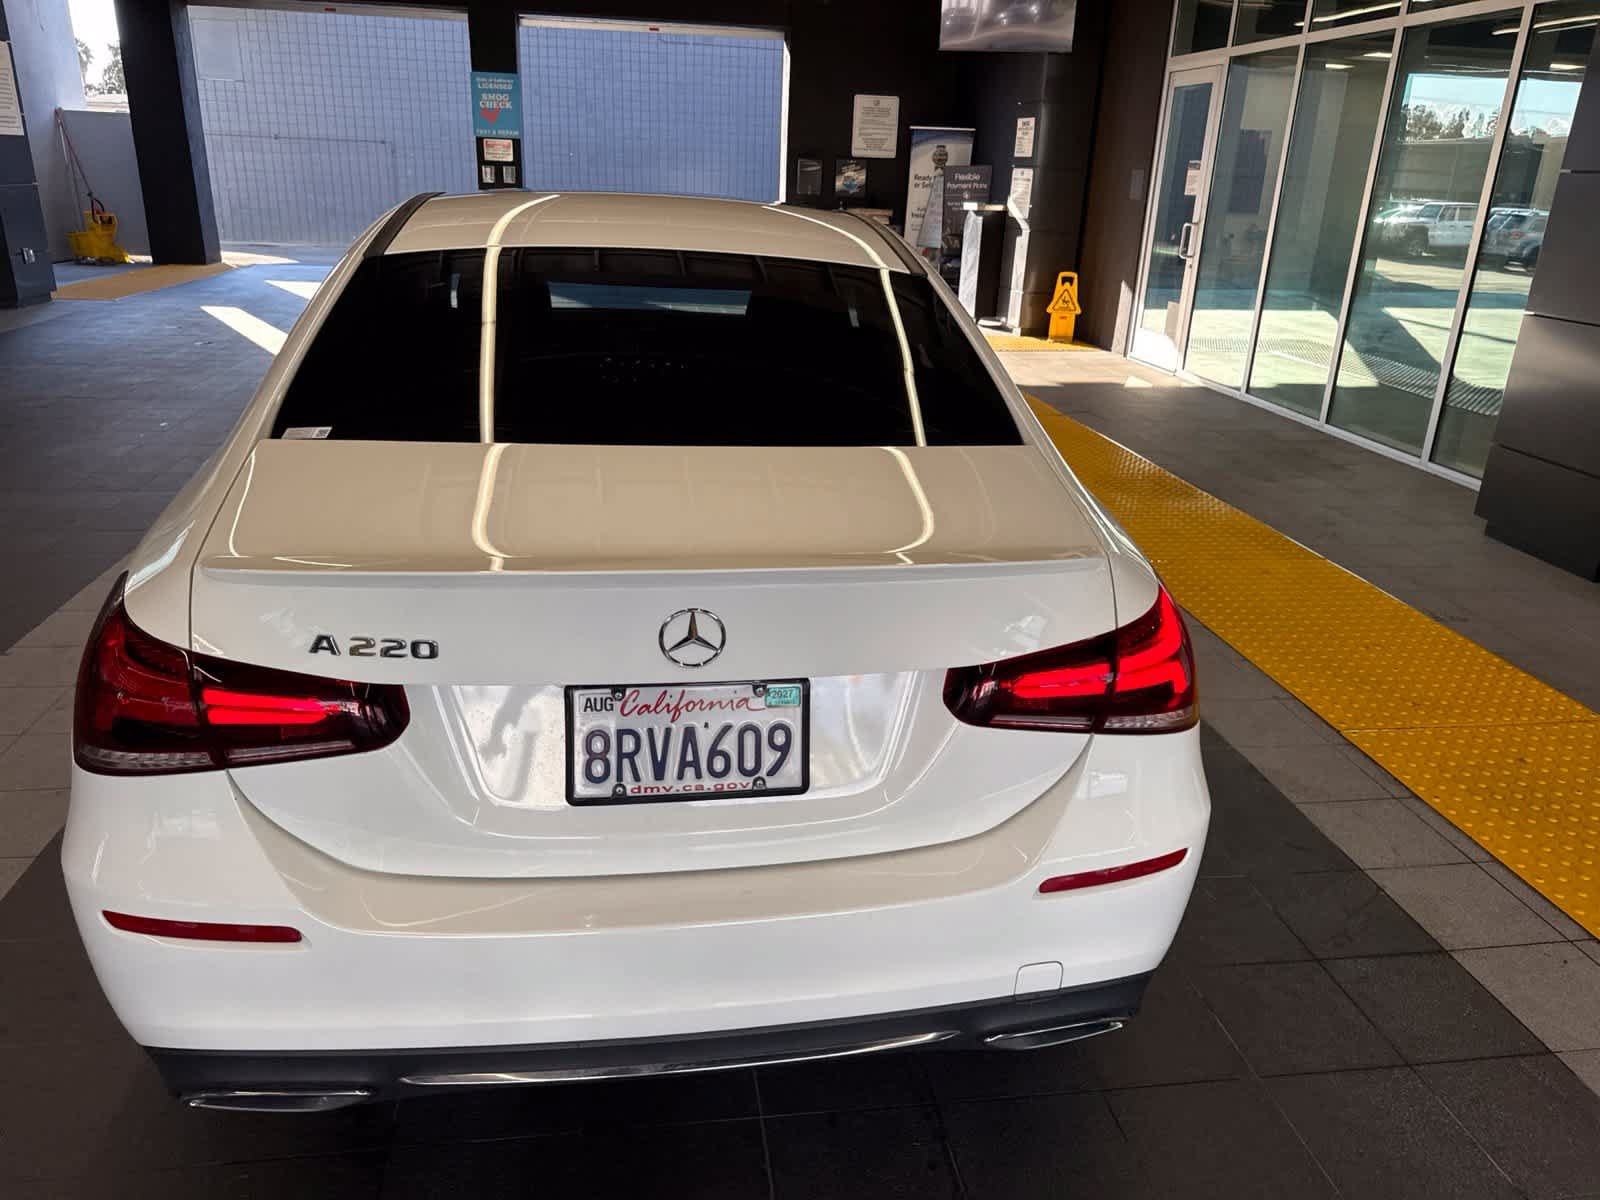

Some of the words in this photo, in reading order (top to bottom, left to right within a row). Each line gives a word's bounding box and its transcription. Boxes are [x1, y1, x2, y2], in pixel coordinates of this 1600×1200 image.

[480, 101, 513, 109] CHECK
[308, 635, 341, 656] A
[349, 637, 439, 660] 220
[770, 688, 794, 699] 2027
[584, 697, 614, 713] AUG
[620, 689, 766, 723] California
[584, 723, 793, 784] 8RVA609
[630, 781, 751, 794] dmv.ca.gov
